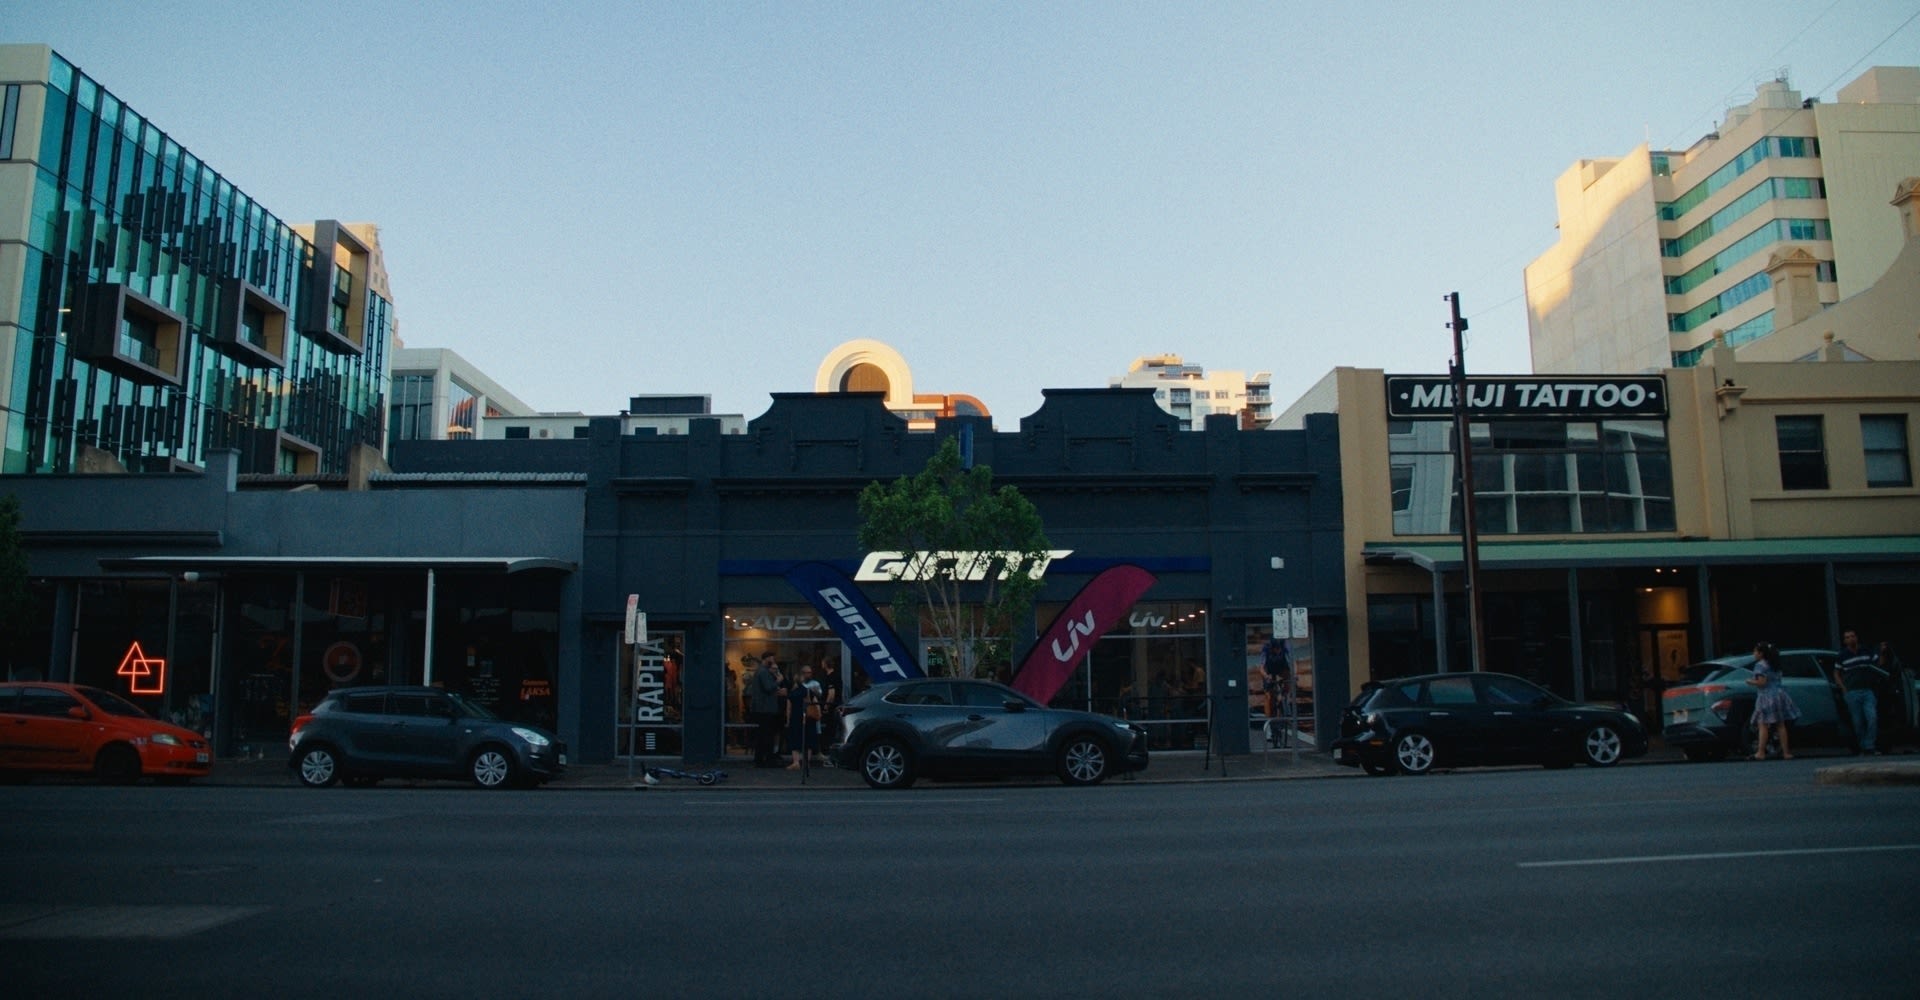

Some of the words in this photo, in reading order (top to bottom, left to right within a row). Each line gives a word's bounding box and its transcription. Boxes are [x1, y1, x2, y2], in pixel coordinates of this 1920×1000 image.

[1515, 383, 1646, 408] TATTOO
[854, 550, 1074, 581] GIANT
[732, 615, 831, 631] CADEX
[818, 586, 908, 680] GIANT
[1051, 609, 1097, 663] Liv
[637, 637, 665, 723] RAPHA
